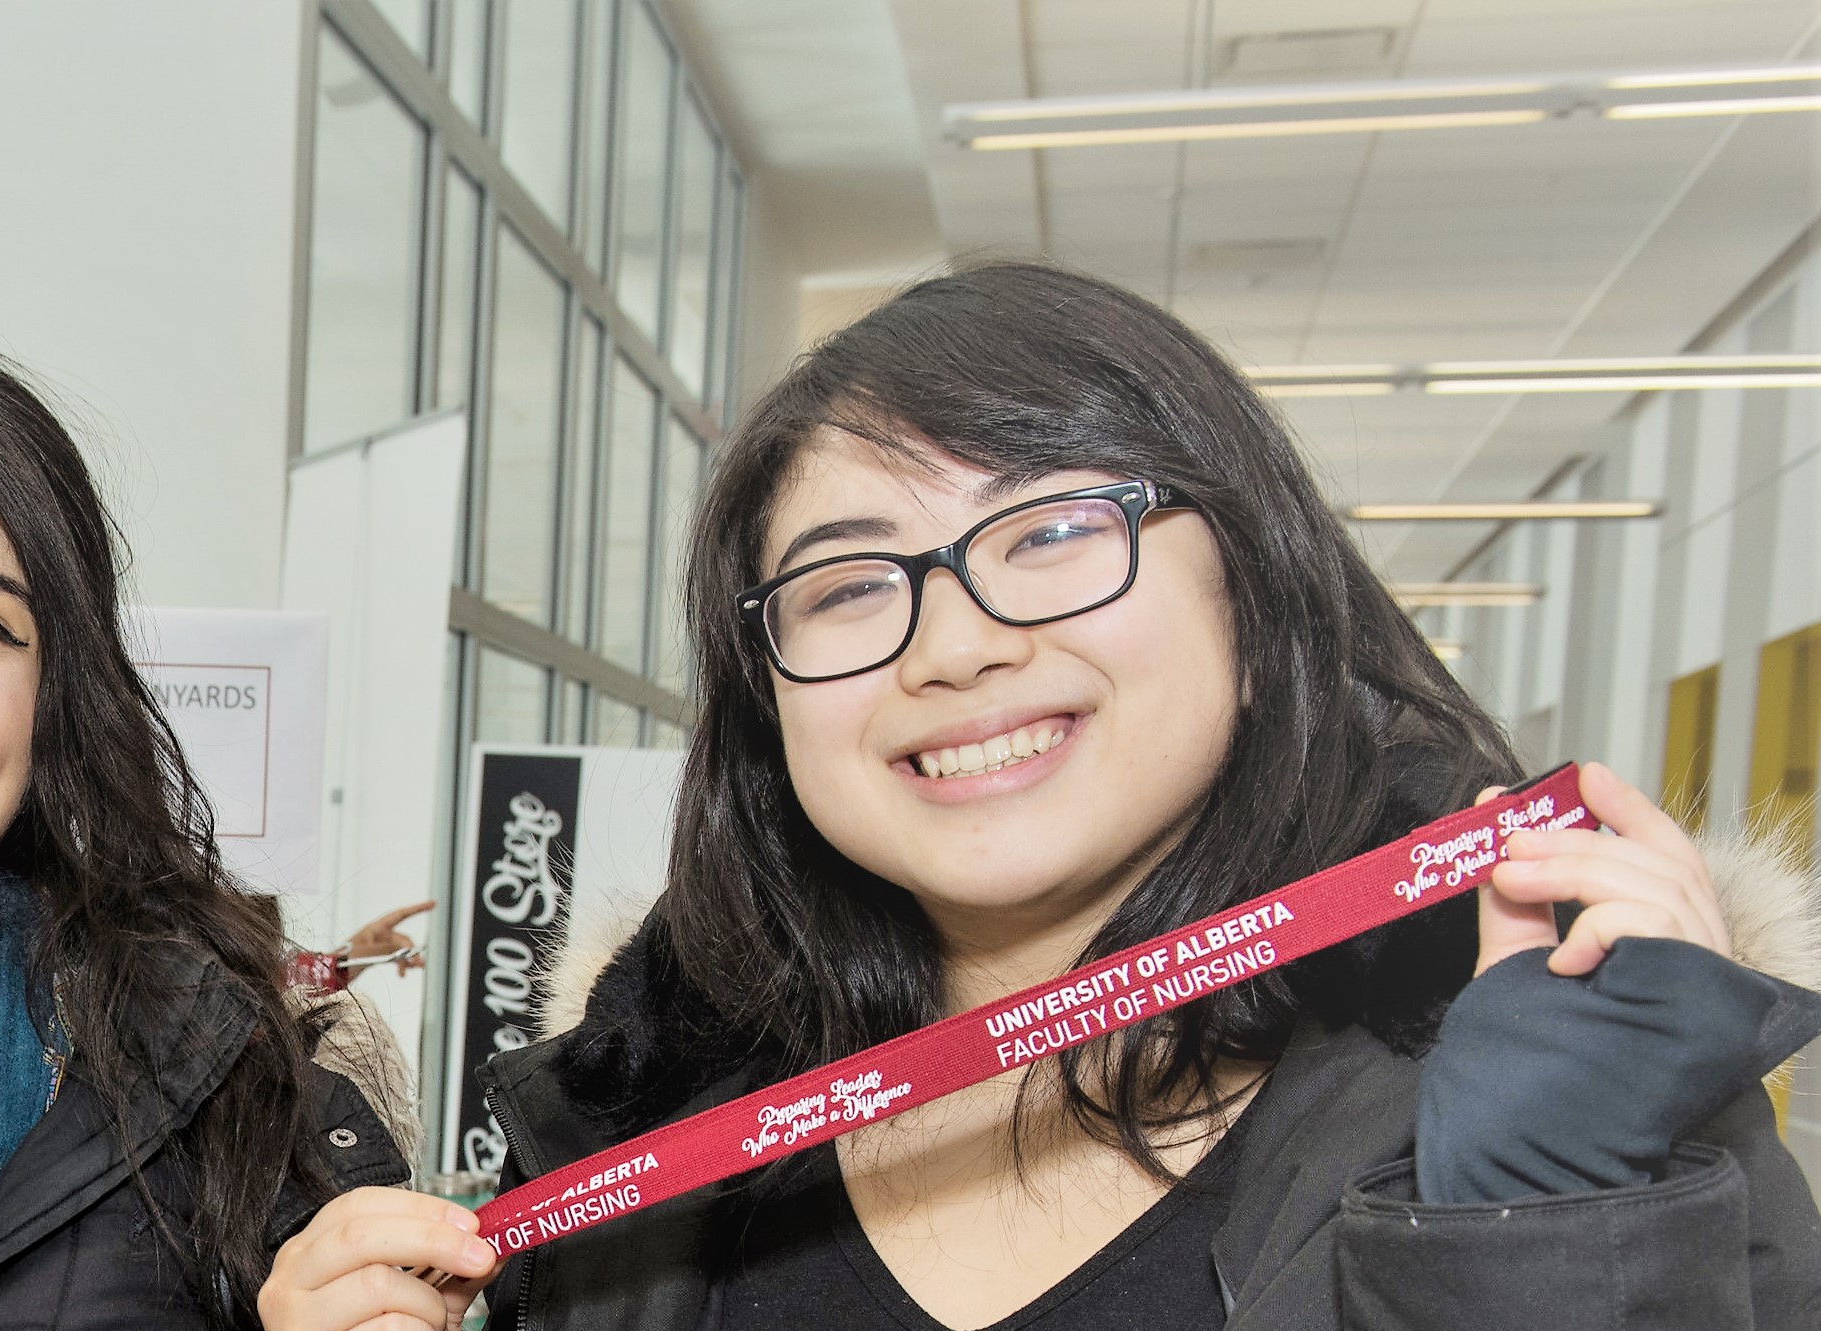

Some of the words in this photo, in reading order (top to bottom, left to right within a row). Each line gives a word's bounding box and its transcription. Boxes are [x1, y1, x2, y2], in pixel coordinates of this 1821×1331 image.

[154, 684, 257, 710] NYARDS
[482, 791, 562, 926] Store
[1409, 826, 1494, 866] Preparing
[1497, 794, 1554, 837] Leaders
[1393, 870, 1440, 903] Who
[1445, 850, 1497, 887] Make
[484, 937, 533, 1018] 100
[985, 963, 1130, 1038] UNIVERSITY
[1136, 948, 1169, 979] OF
[1176, 900, 1294, 965] ALBERTA
[996, 1004, 1107, 1068] FACULTY
[1113, 988, 1148, 1021] OF
[1153, 940, 1276, 1007] NURSING
[741, 1127, 779, 1158] Who
[784, 1114, 827, 1145] Make
[829, 1110, 840, 1123] a
[843, 1082, 912, 1121] Difference
[758, 1093, 826, 1127] Preparing
[830, 1069, 883, 1103] Leaders
[560, 1152, 659, 1202] ALBERTA
[506, 1221, 532, 1249] OF
[537, 1184, 641, 1239] NURSING
